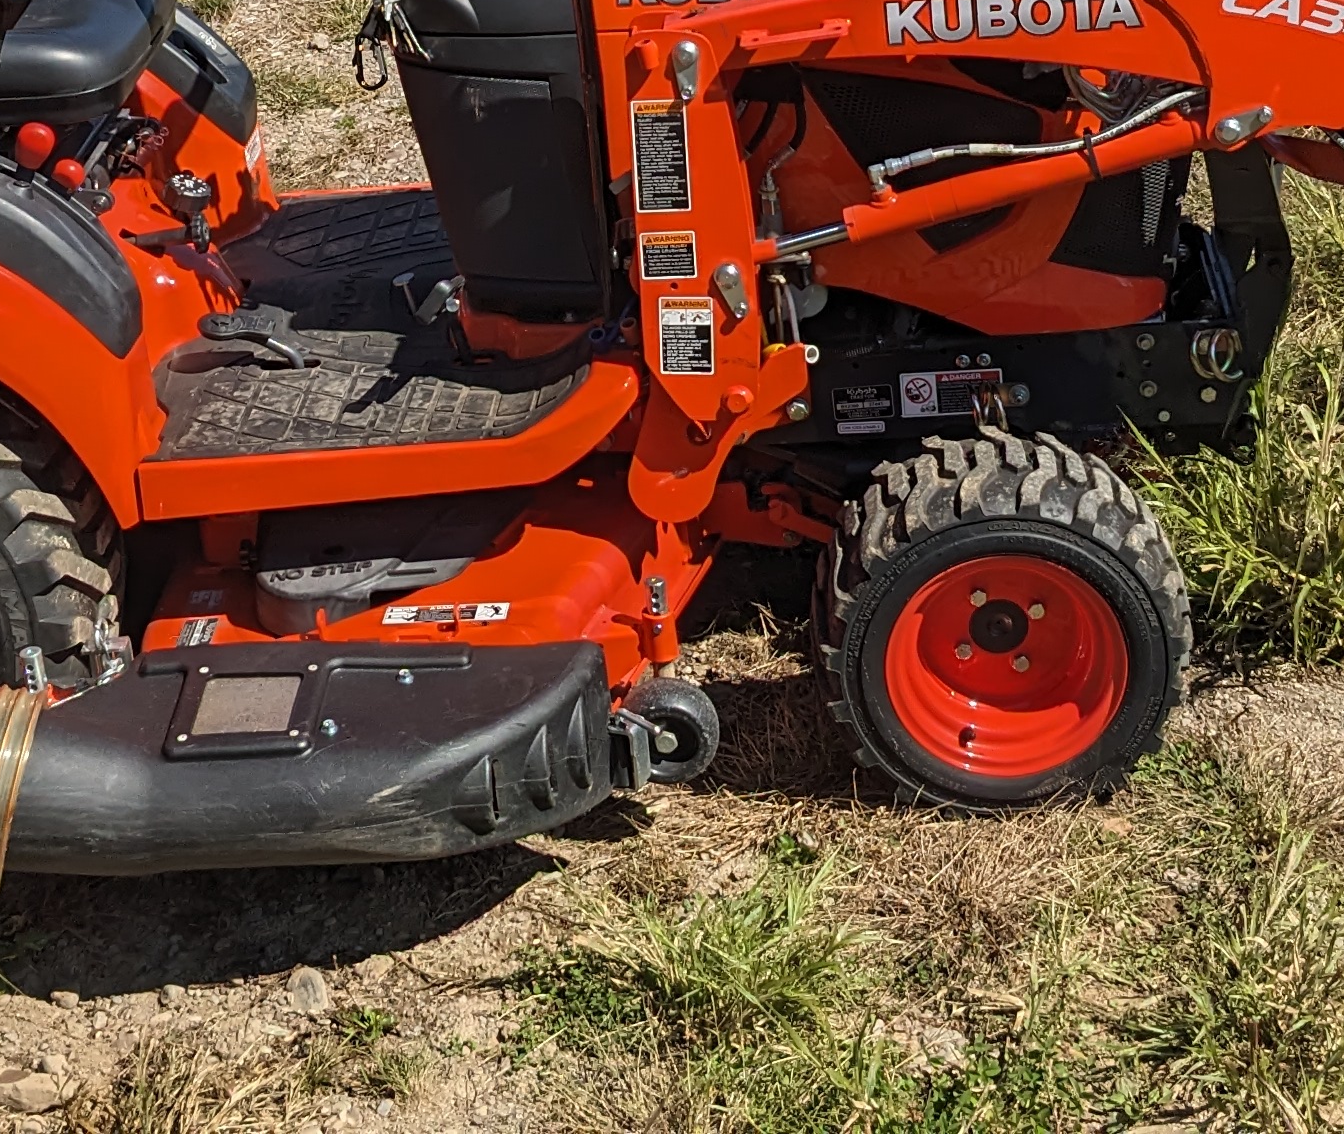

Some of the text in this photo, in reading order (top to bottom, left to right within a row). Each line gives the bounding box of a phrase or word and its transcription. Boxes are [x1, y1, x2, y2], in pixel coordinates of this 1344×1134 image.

[653, 234, 690, 243] WARNING
[671, 300, 708, 308] WARNING
[949, 372, 982, 382] DANGER
[846, 387, 877, 396] Kubota
[988, 519, 1085, 547] GARDEN
[269, 560, 373, 583] NO STEP
